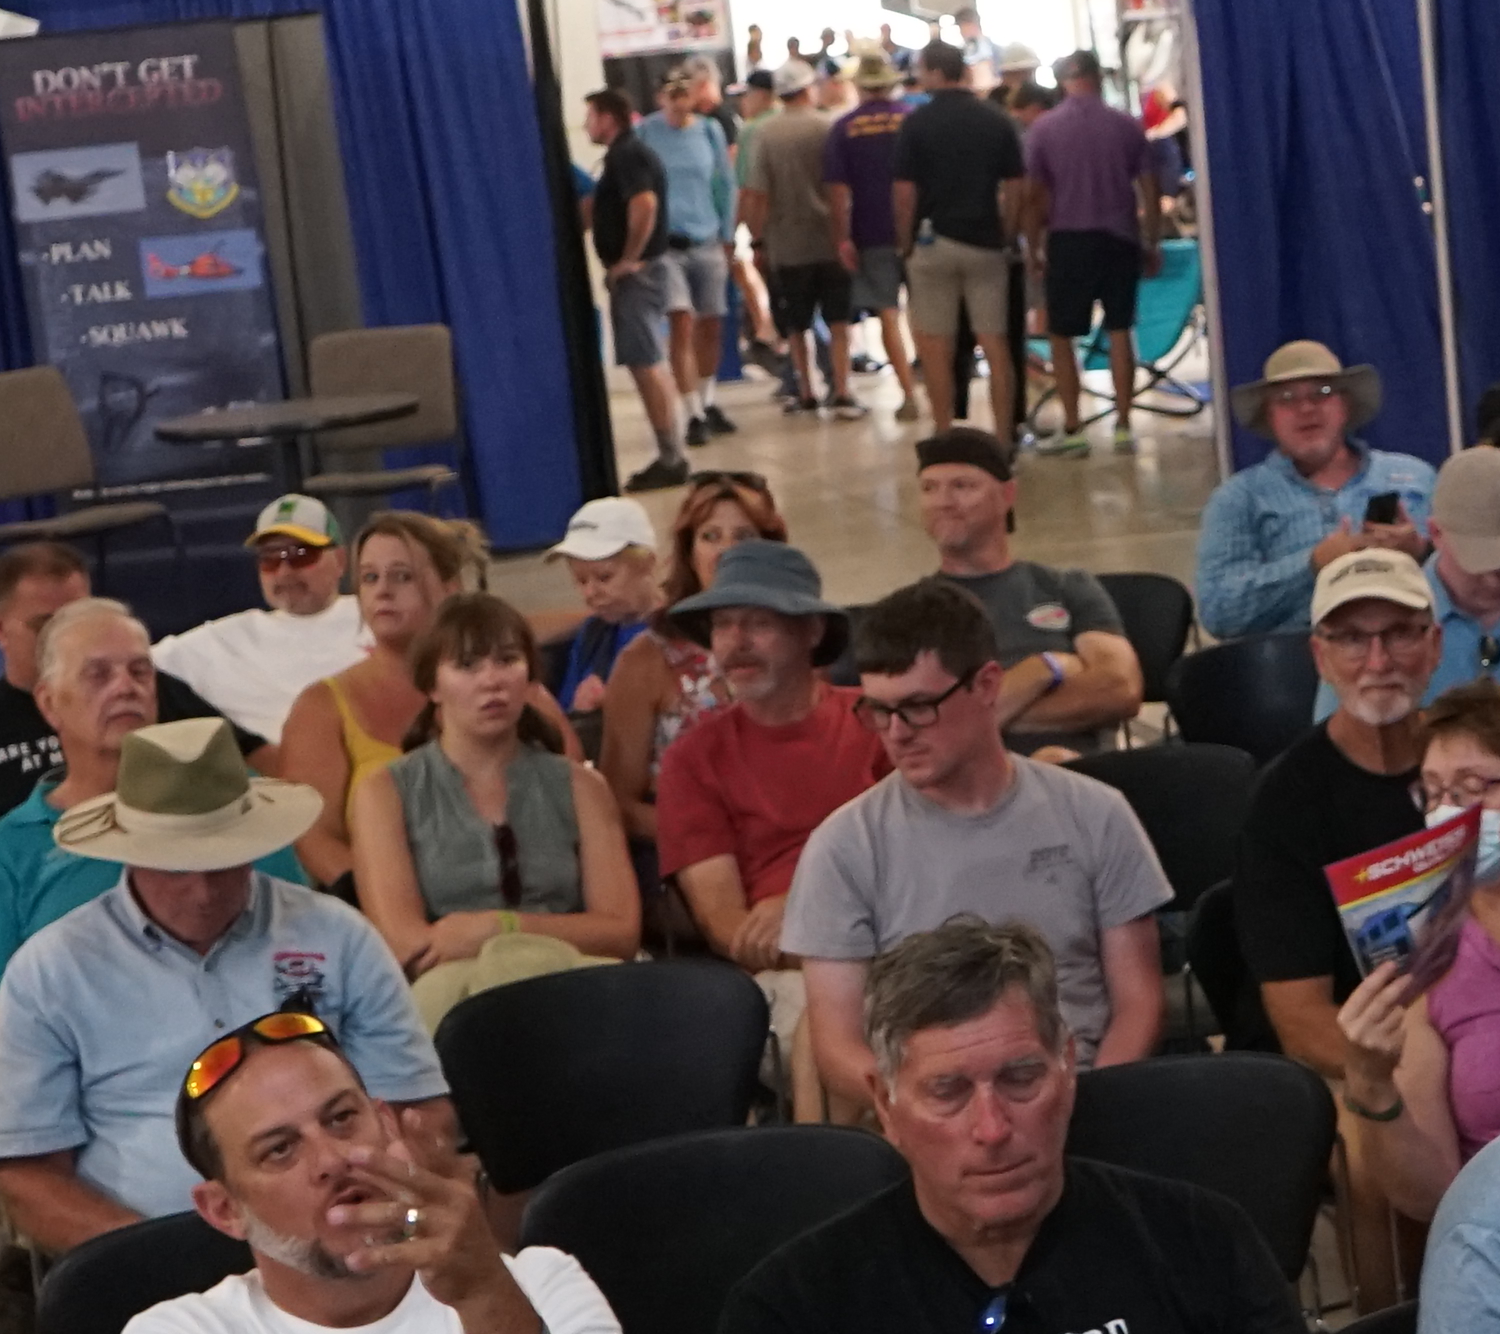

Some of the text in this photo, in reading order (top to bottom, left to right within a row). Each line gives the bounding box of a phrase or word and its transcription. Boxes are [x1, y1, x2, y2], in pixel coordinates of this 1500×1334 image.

[33, 54, 198, 96] DON'T GET
[36, 735, 60, 752] YO
[22, 753, 41, 772] AT
